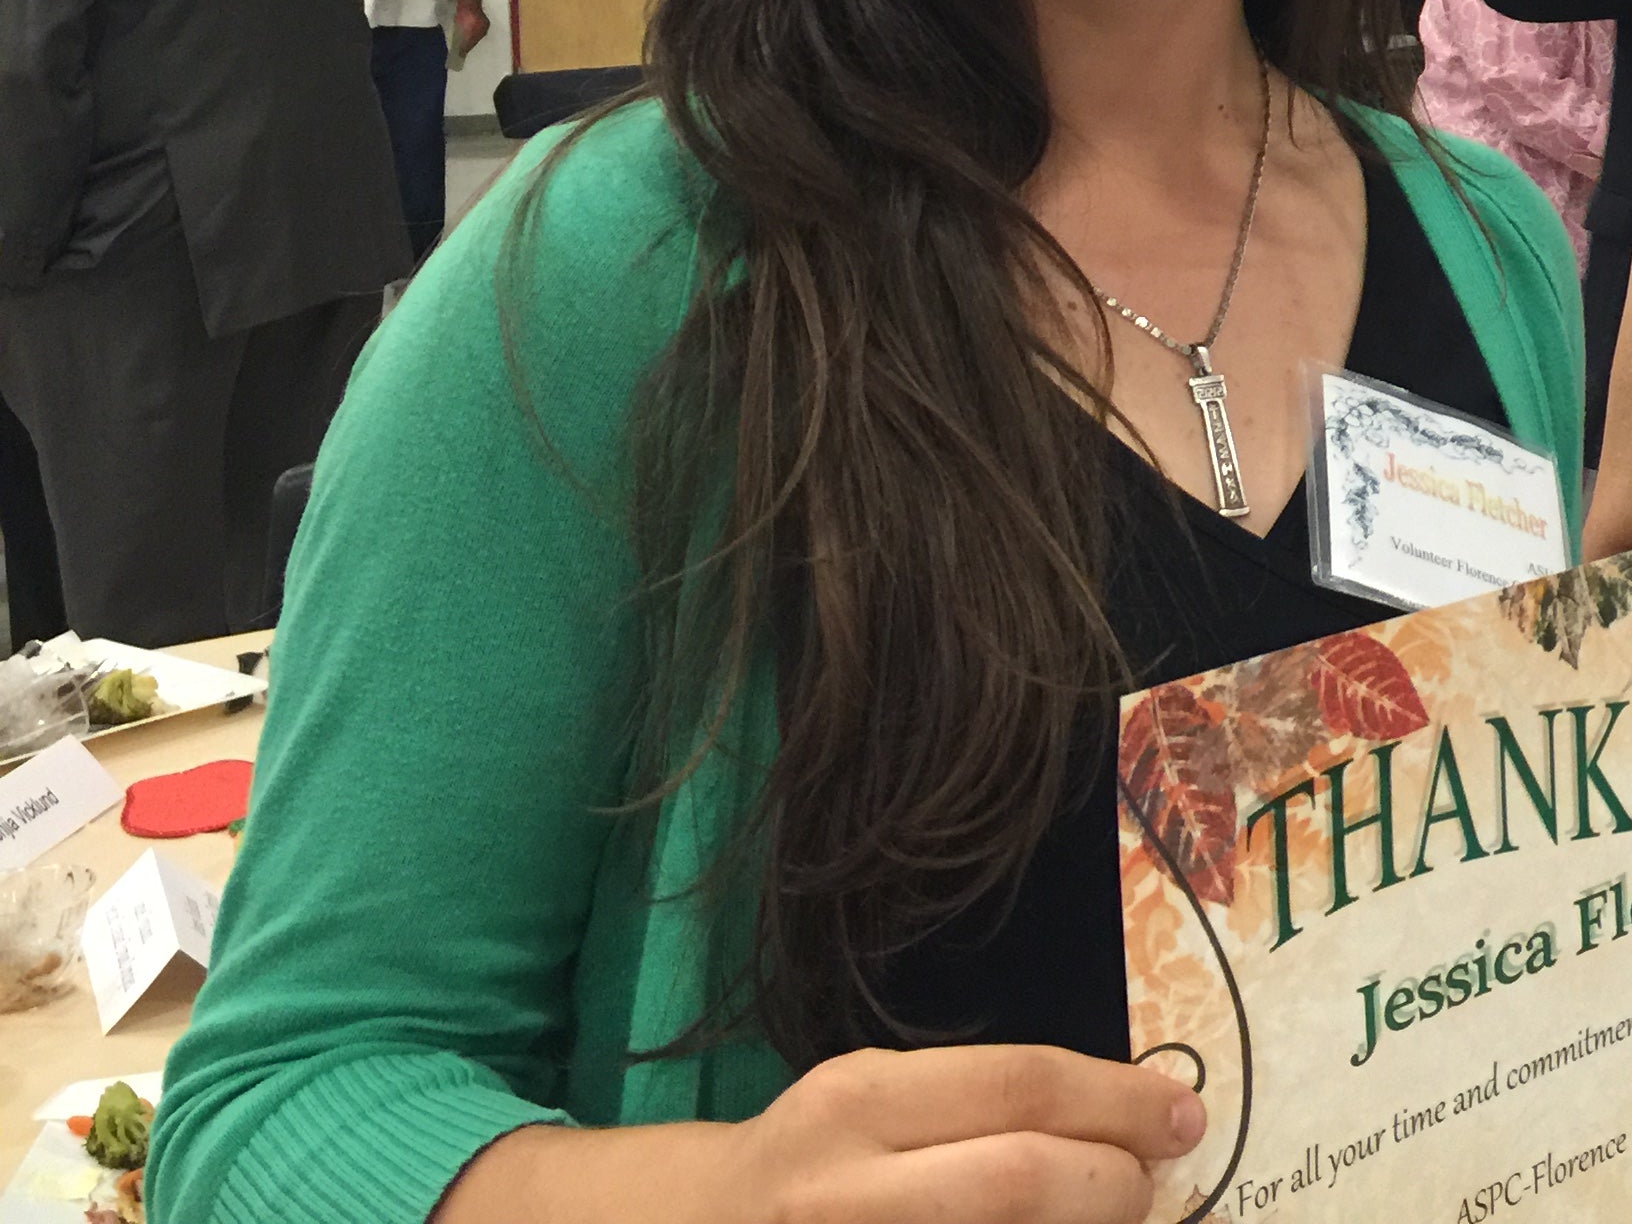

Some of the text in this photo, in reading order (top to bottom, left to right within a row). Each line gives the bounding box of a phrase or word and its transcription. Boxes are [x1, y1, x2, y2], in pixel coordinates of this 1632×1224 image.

[1383, 451, 1548, 541] Jessica Fletcher
[1390, 535, 1454, 570] Volunteer
[10, 786, 60, 824] Vicklund
[1350, 927, 1559, 1067] Jessica
[1236, 1177, 1283, 1217] For
[1290, 1143, 1322, 1193] all
[1327, 1128, 1386, 1188] your
[1392, 1099, 1447, 1144] time
[1452, 1060, 1500, 1116] and
[1456, 1130, 1628, 1224] ASPC-Florence
